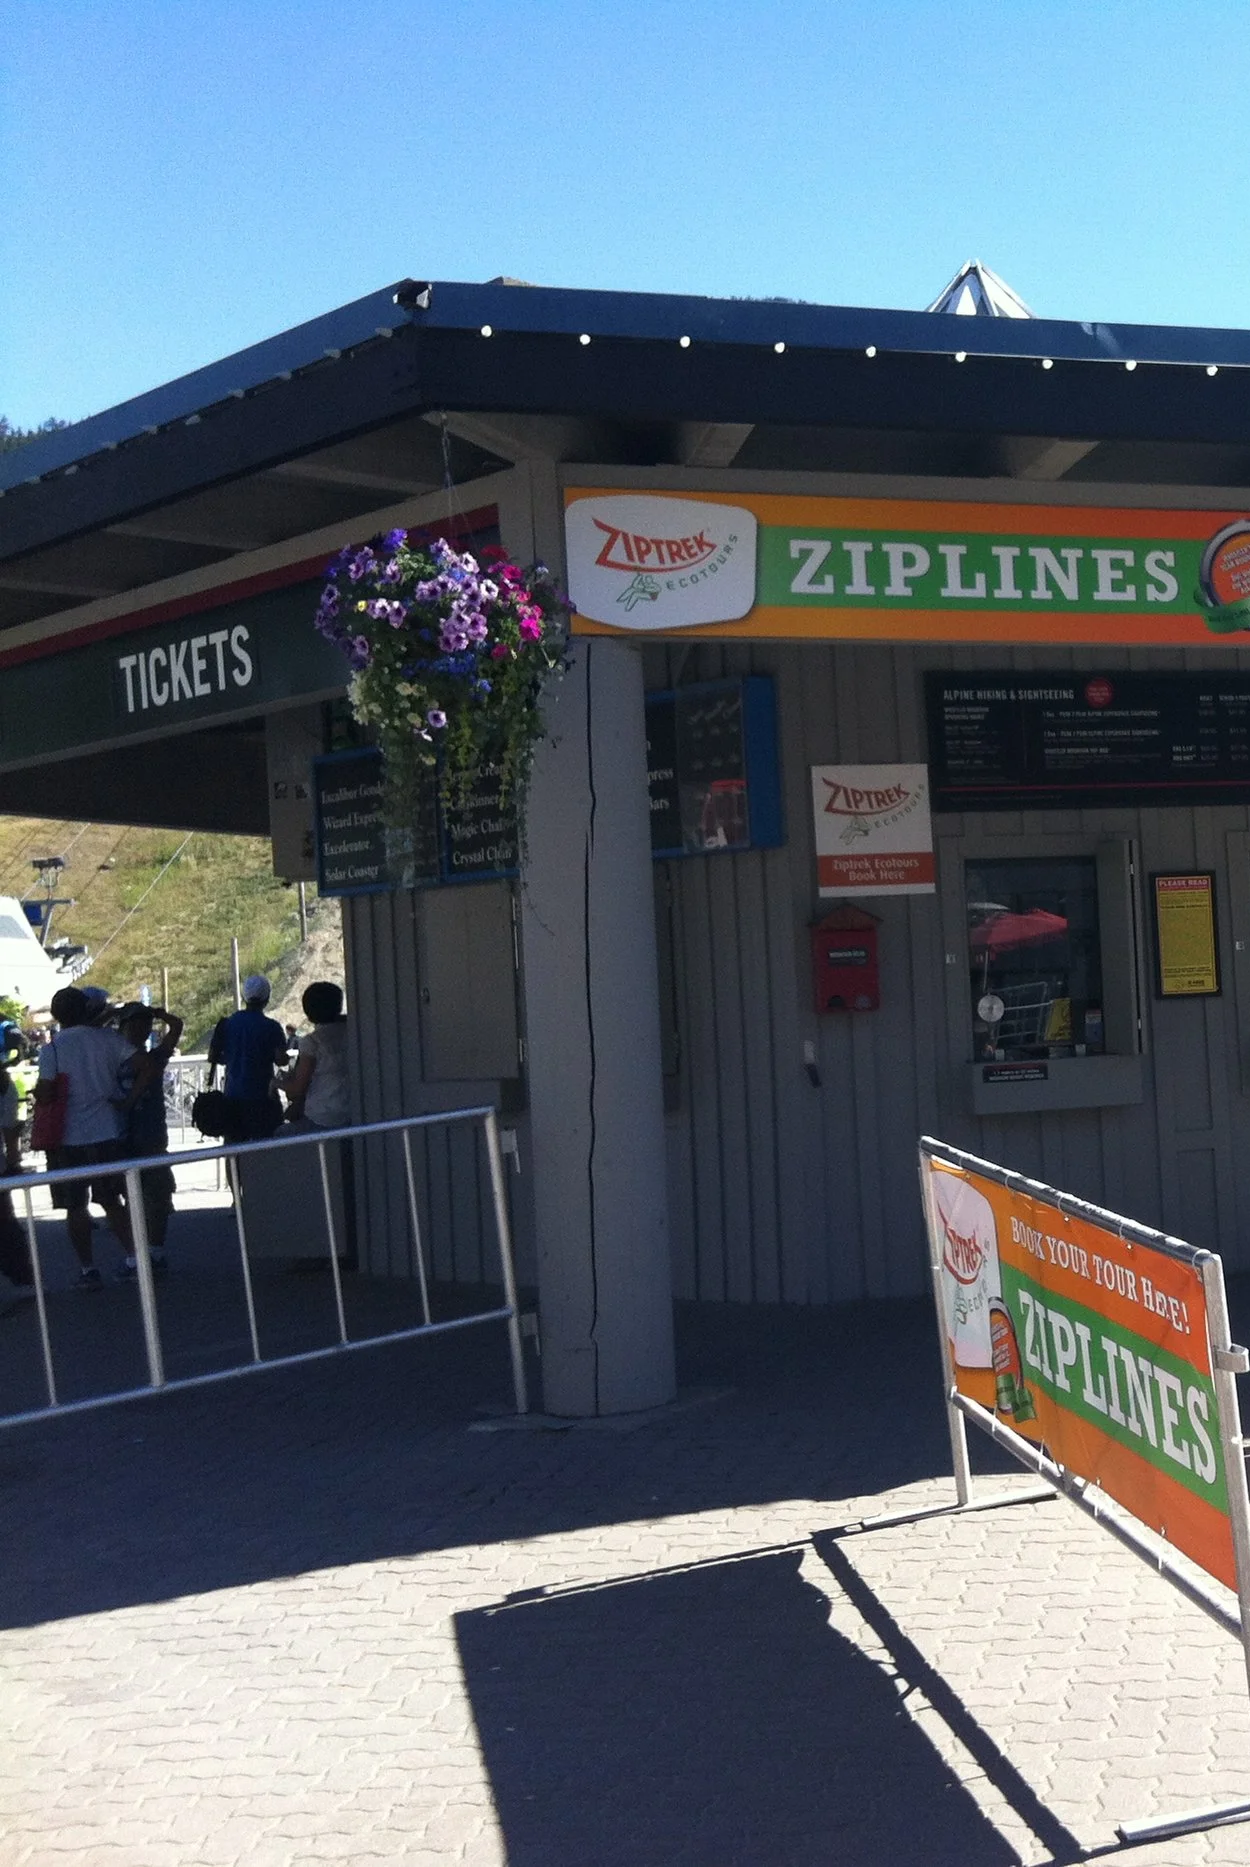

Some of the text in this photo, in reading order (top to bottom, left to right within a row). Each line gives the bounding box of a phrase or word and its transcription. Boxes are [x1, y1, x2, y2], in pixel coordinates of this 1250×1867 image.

[592, 517, 717, 573] ZIPTREK
[667, 534, 738, 591] ECOTOURS
[789, 539, 1178, 602] ZIPLINES
[119, 625, 254, 713] TICKETS
[943, 689, 974, 700] ALPINE
[977, 689, 1007, 700] HIKING
[1018, 689, 1074, 700] SIGHTSEEING
[647, 768, 674, 786] press
[822, 777, 910, 816] ZIPTREK
[875, 784, 925, 829] ECOTOURS
[849, 869, 904, 881] Book Here
[875, 857, 919, 869] Ecotours
[1010, 1216, 1191, 1335] BOOK YOUR TOUR HERE!
[1018, 1288, 1217, 1485] ZIPLINES
